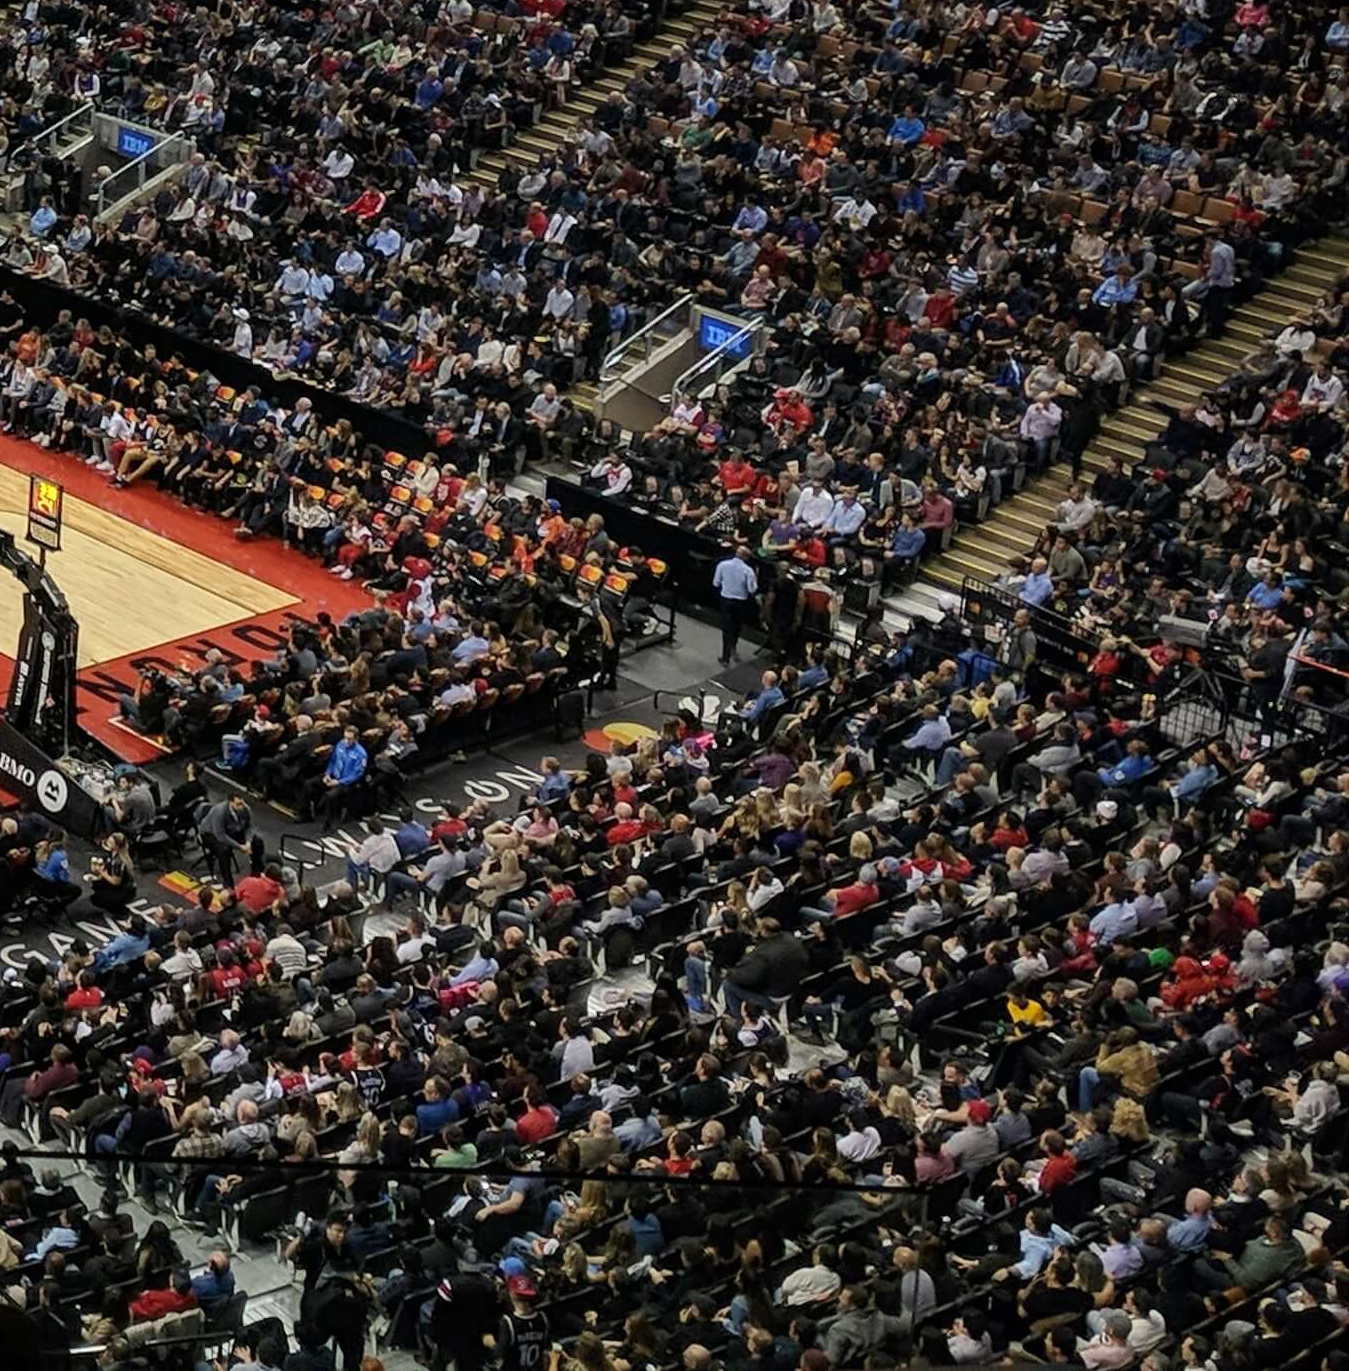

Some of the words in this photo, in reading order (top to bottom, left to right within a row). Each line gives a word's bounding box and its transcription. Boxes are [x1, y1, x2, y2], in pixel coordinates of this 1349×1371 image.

[122, 136, 150, 156] IBM
[464, 764, 545, 802] ON
[0, 897, 157, 972] GAME
[517, 1344, 540, 1366] 10
